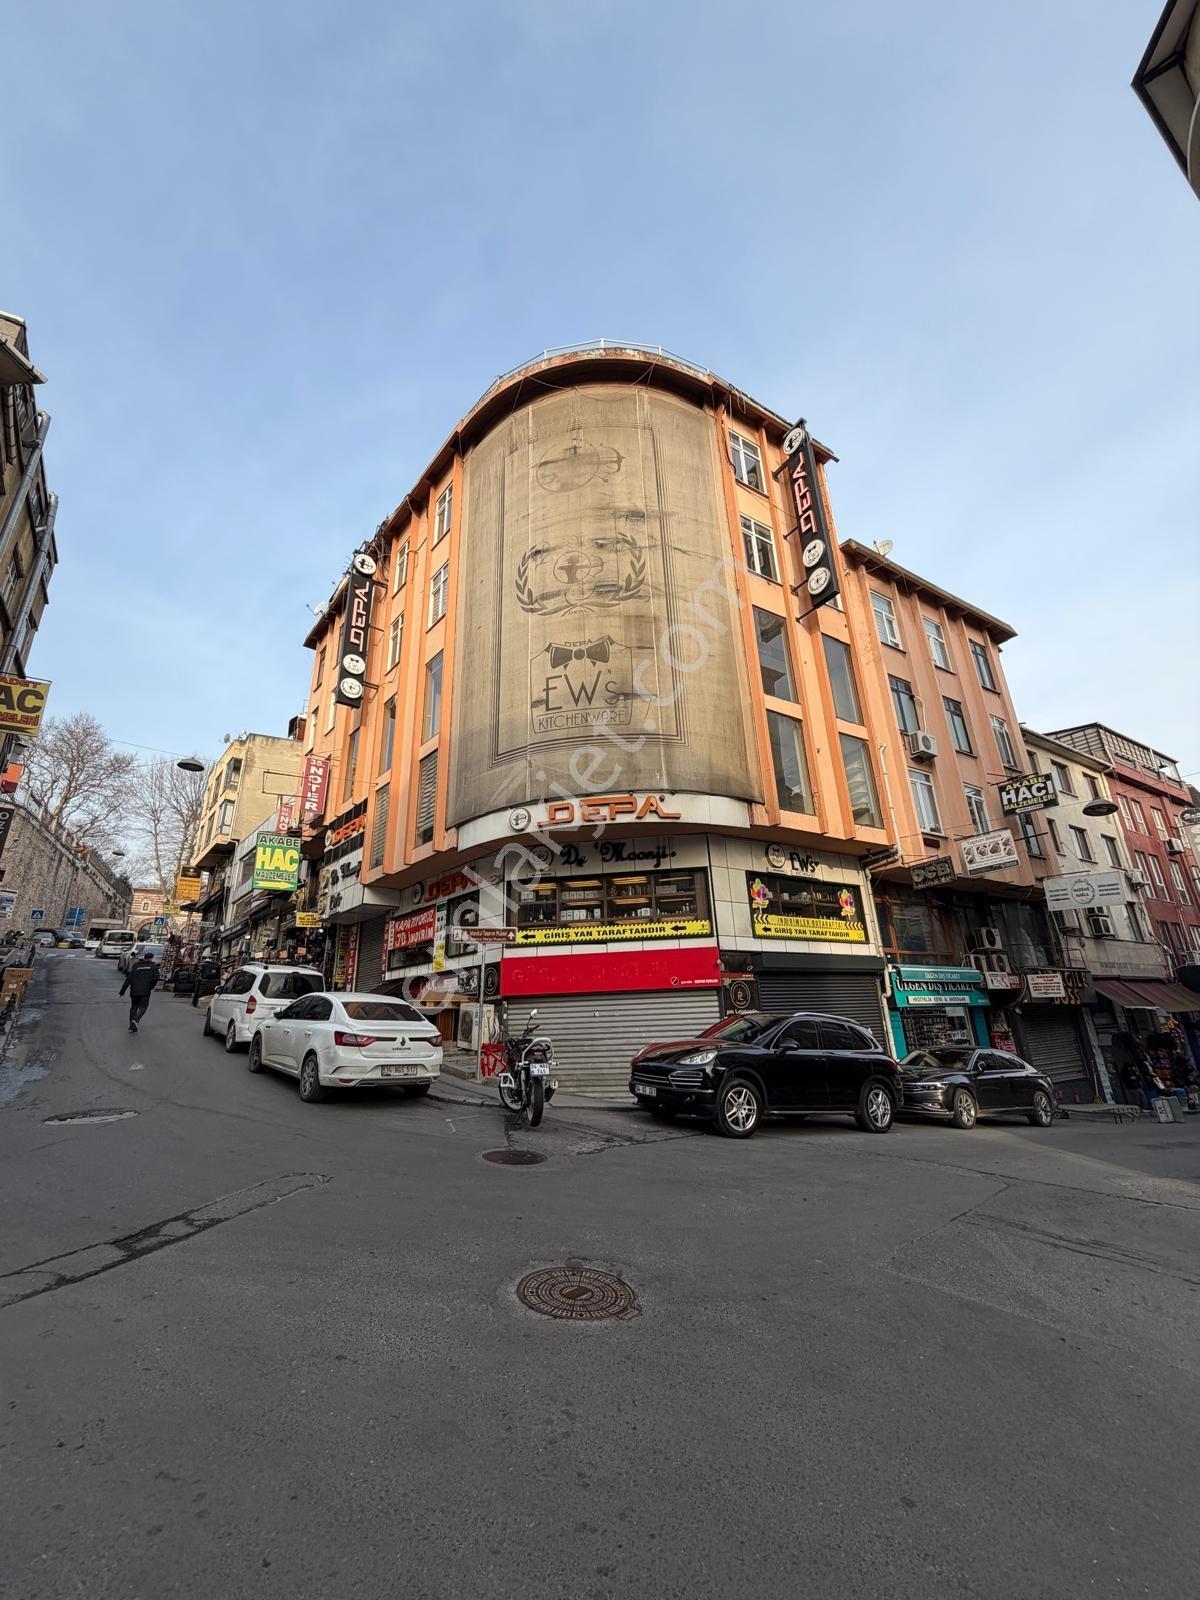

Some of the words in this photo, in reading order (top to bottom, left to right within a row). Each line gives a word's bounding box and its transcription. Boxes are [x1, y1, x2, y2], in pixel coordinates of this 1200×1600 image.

[793, 451, 818, 533] DEPA
[350, 581, 369, 652] DEPA
[538, 709, 625, 731] KITCHENWARE
[304, 766, 323, 812] NOTER
[1001, 780, 1055, 805] HACI
[1005, 776, 1046, 791] AKABE
[537, 794, 682, 828] DEPA
[259, 835, 300, 847] AKABE
[255, 847, 298, 871] HAC
[543, 930, 571, 940] GİRİŞ
[574, 928, 593, 939] YAN
[597, 925, 666, 938] TARAFTANDIR
